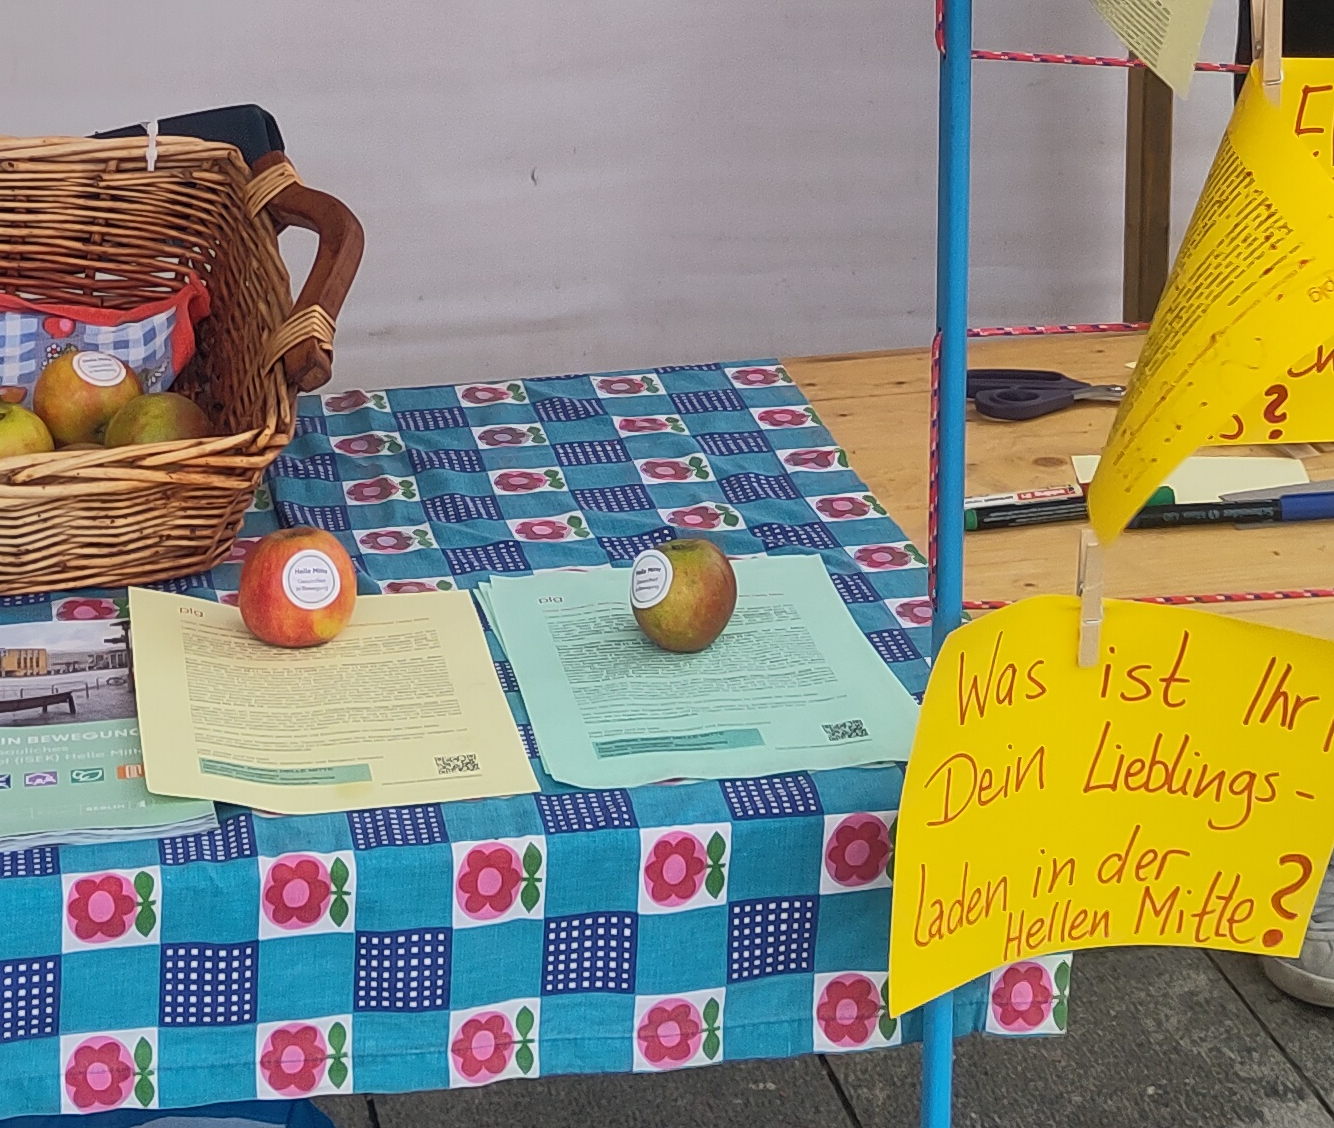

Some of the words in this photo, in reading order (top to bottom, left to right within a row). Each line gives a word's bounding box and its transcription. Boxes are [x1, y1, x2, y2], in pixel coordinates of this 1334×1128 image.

[178, 606, 205, 619] plg
[959, 630, 1048, 725] Was
[1100, 630, 1191, 708] ist
[1243, 656, 1319, 731] Ihr
[1, 736, 21, 745] IN
[15, 754, 59, 765] (ISEK)
[65, 751, 104, 761] Helle
[110, 746, 141, 757] Mitt
[924, 744, 1046, 827] Dein
[1083, 720, 1316, 830] Lieblings-
[1032, 849, 1075, 899] in
[1096, 824, 1191, 884] der
[1003, 899, 1109, 961] Hellen
